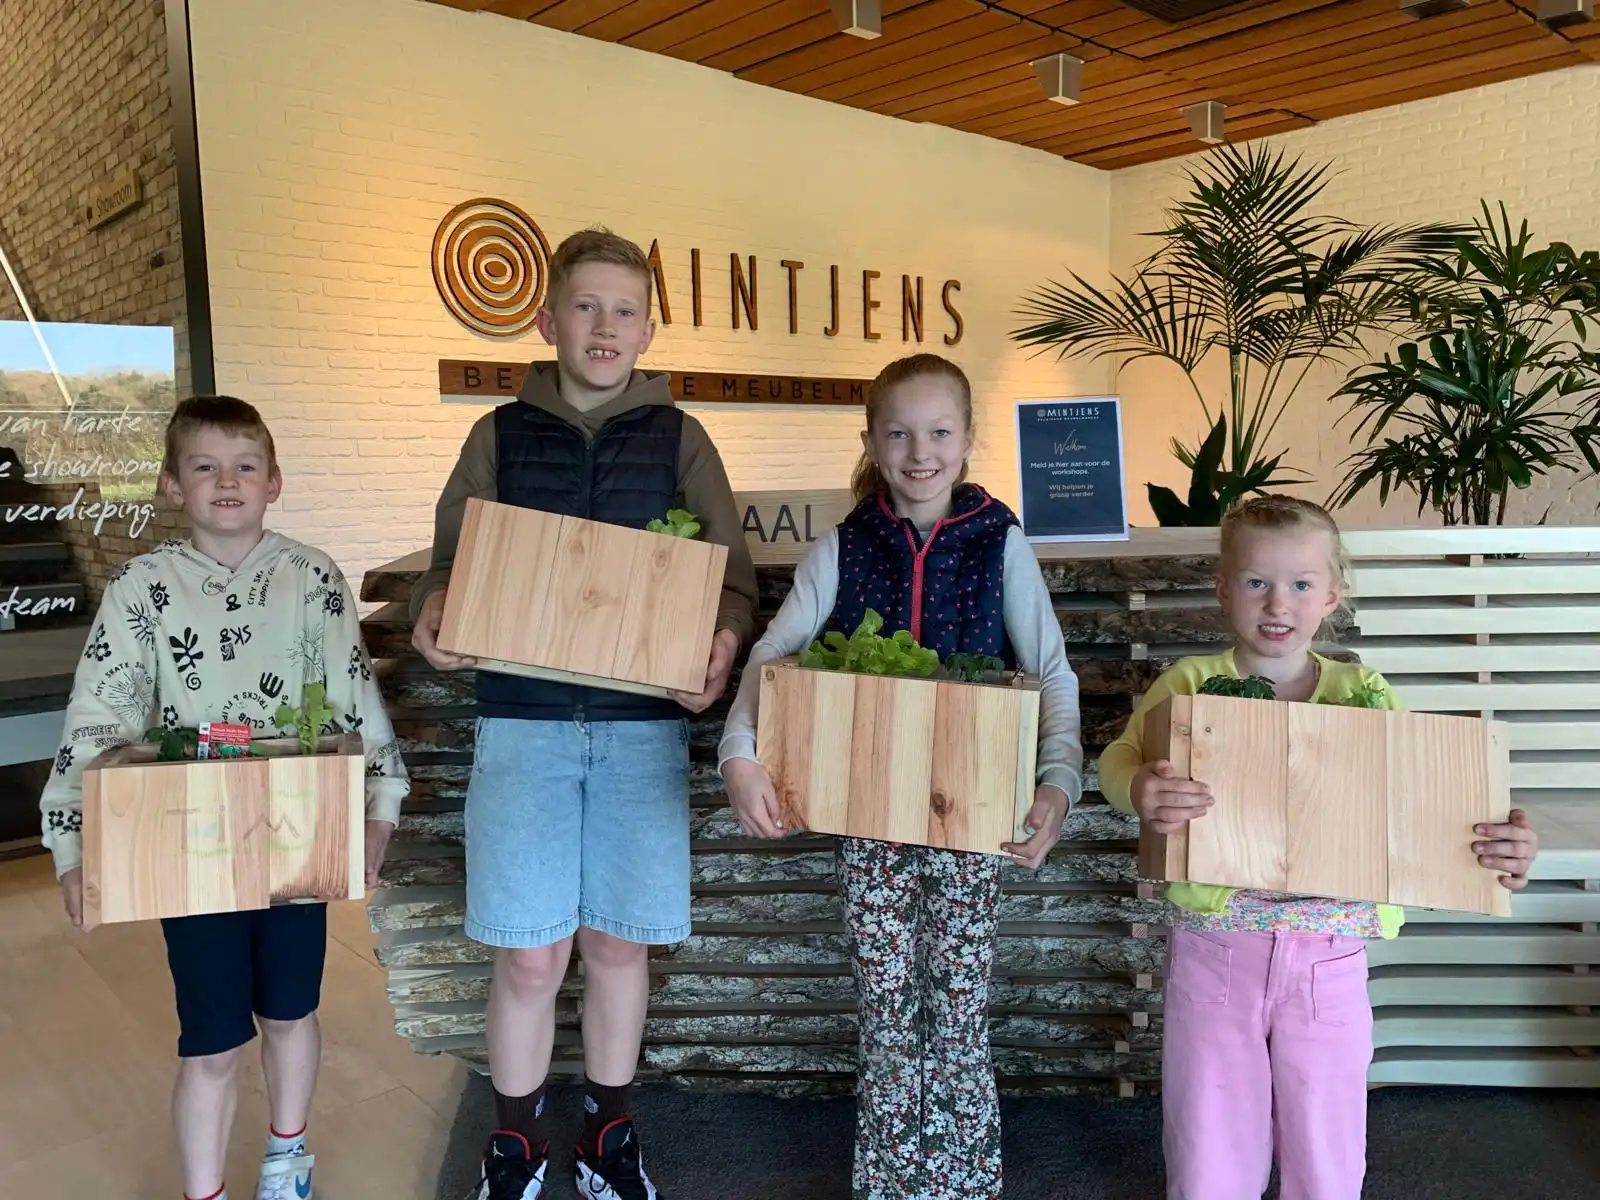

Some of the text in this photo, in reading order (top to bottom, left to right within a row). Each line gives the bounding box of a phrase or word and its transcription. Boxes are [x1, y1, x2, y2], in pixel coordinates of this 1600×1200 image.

[62, 395, 142, 434] harte
[1047, 407, 1100, 417] MINTJENS
[24, 441, 161, 478] showroom
[0, 586, 76, 619] team
[105, 662, 130, 679] SKATE
[242, 691, 268, 710] TRICKS
[238, 712, 265, 729] CLUB
[71, 723, 121, 741] STREET
